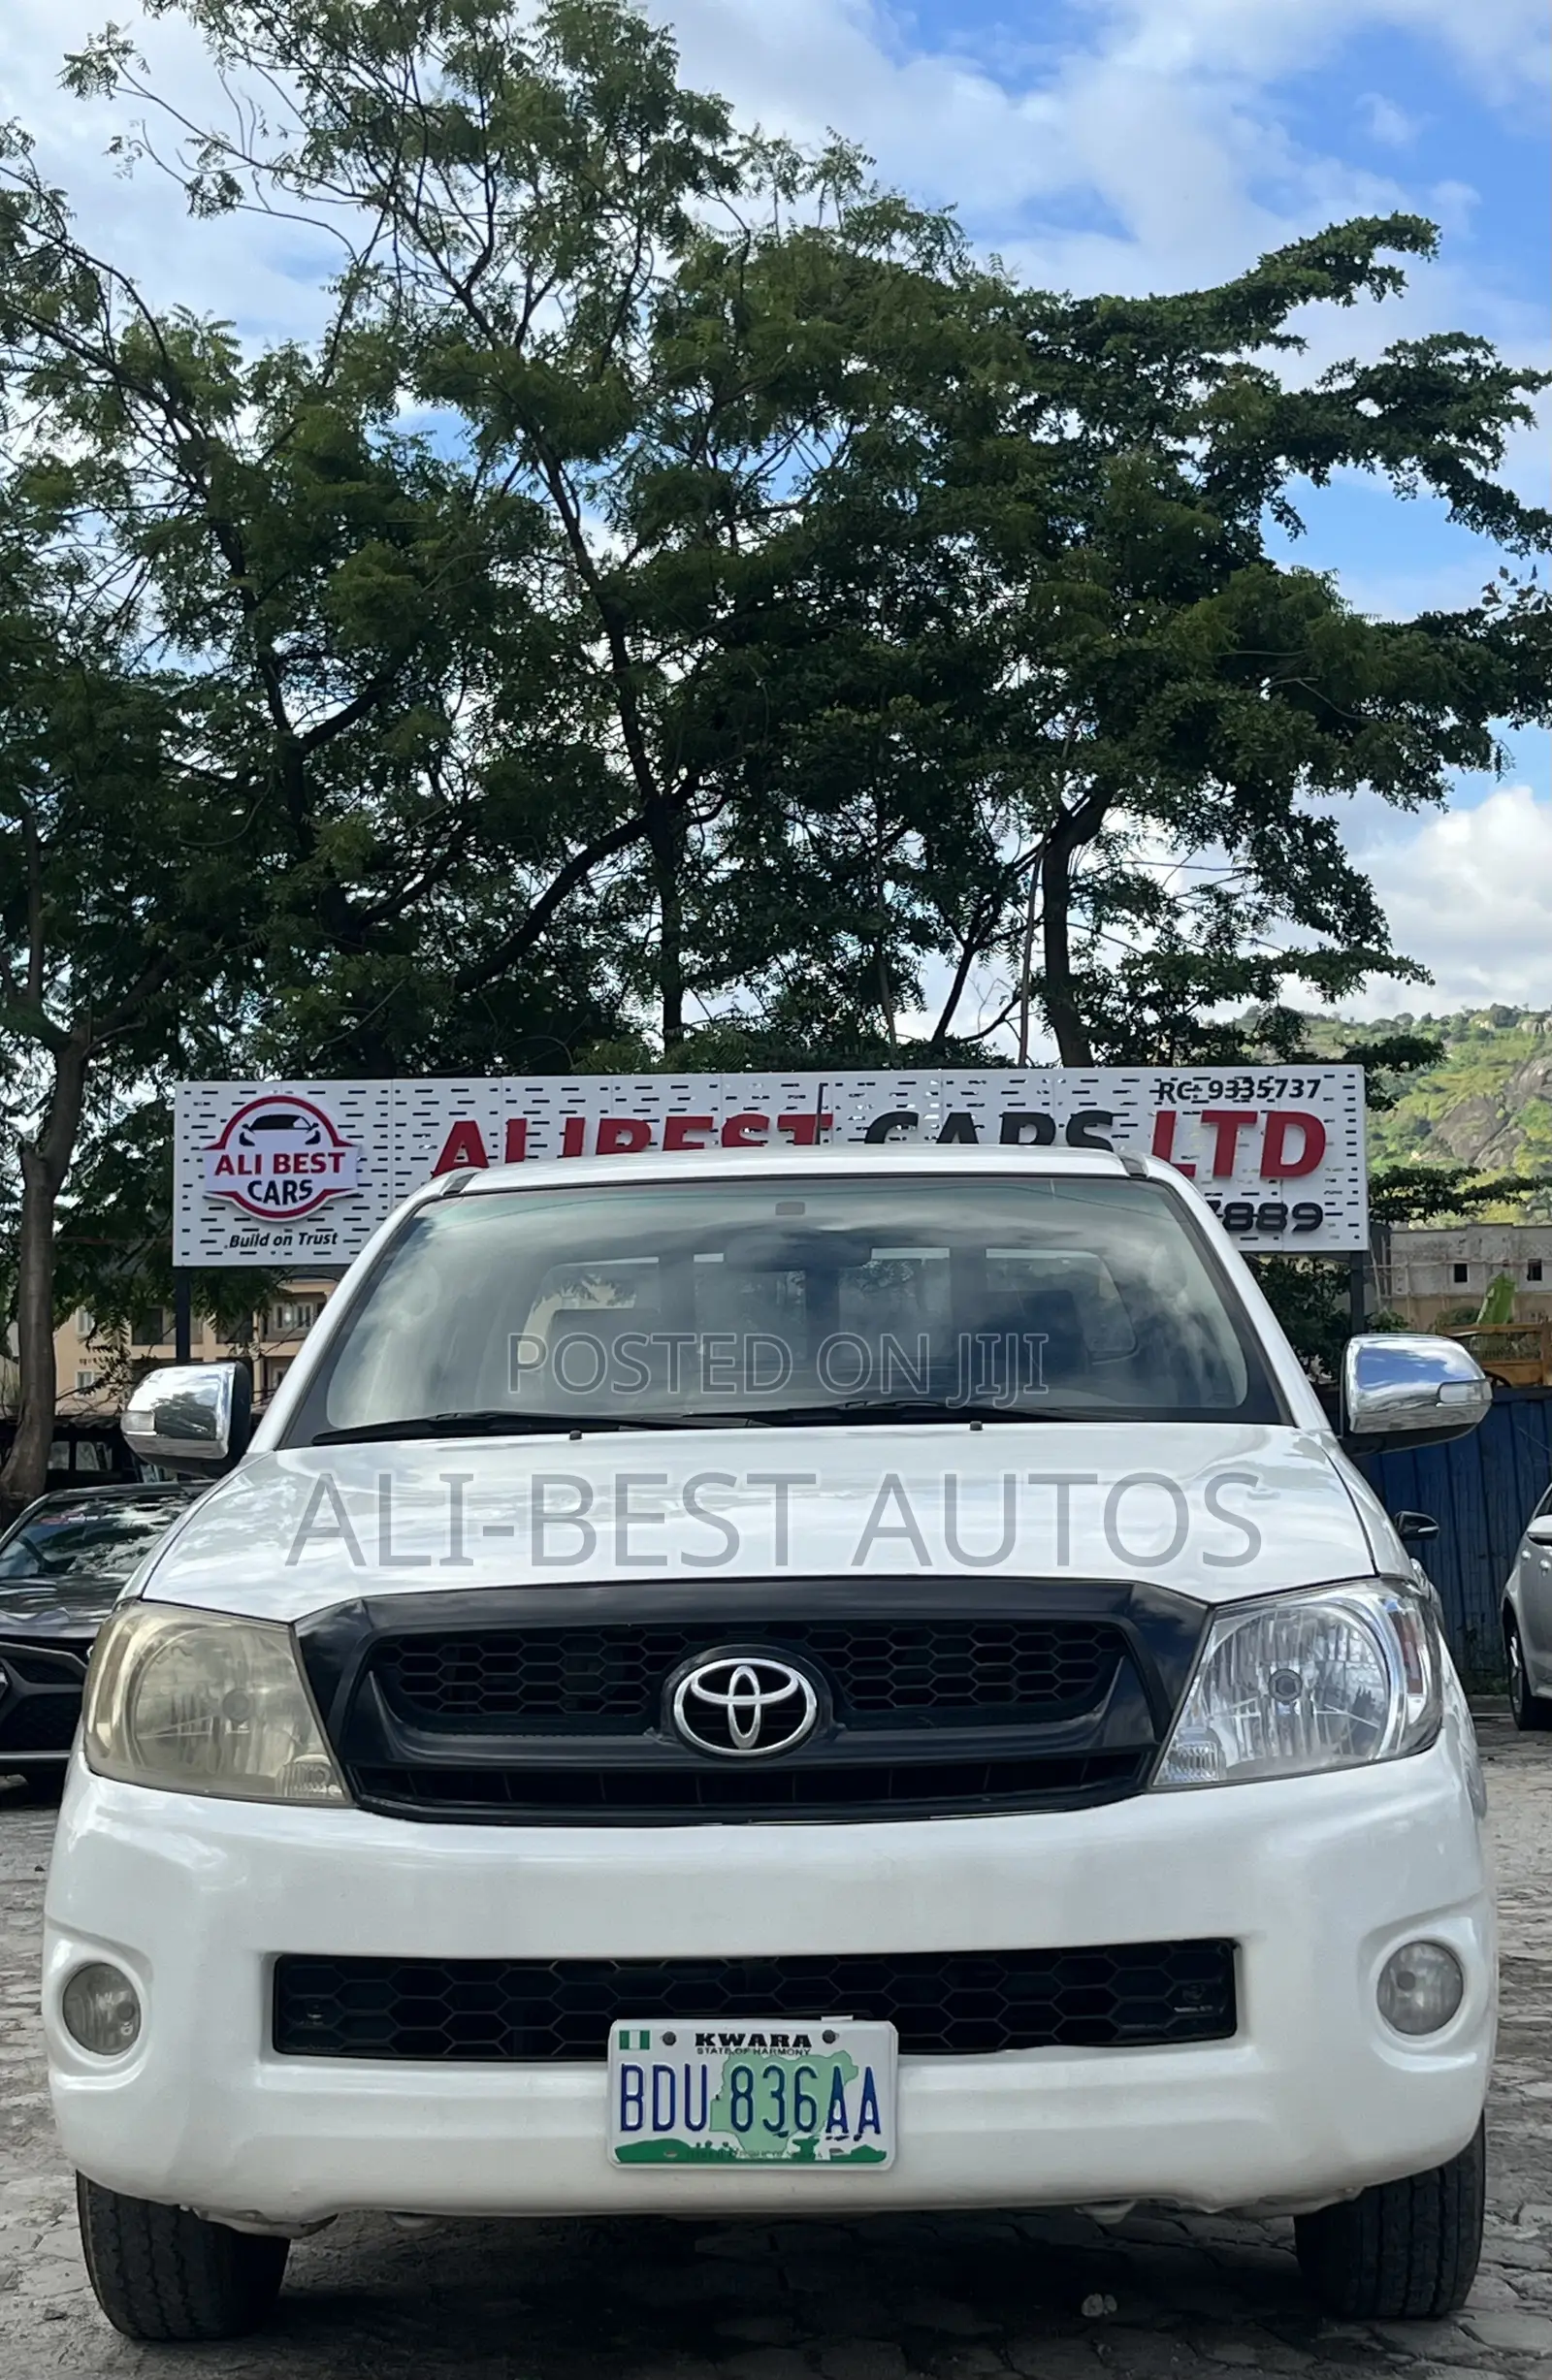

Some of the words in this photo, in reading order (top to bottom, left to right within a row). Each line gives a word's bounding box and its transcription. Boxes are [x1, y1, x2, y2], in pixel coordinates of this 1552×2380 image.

[1208, 1078, 1321, 1100] 9335737
[1151, 1109, 1327, 1178] LTD
[214, 1153, 262, 1175] ALI
[273, 1152, 345, 1174] BEST
[247, 1178, 313, 1206] CARS
[229, 1233, 271, 1248] Build
[273, 1236, 293, 1246] on
[299, 1232, 339, 1245] Trust
[695, 2033, 812, 2047] KWARA
[753, 2046, 811, 2056] HARMONY
[621, 2063, 708, 2132] BDU
[729, 2065, 882, 2134] 836AA
